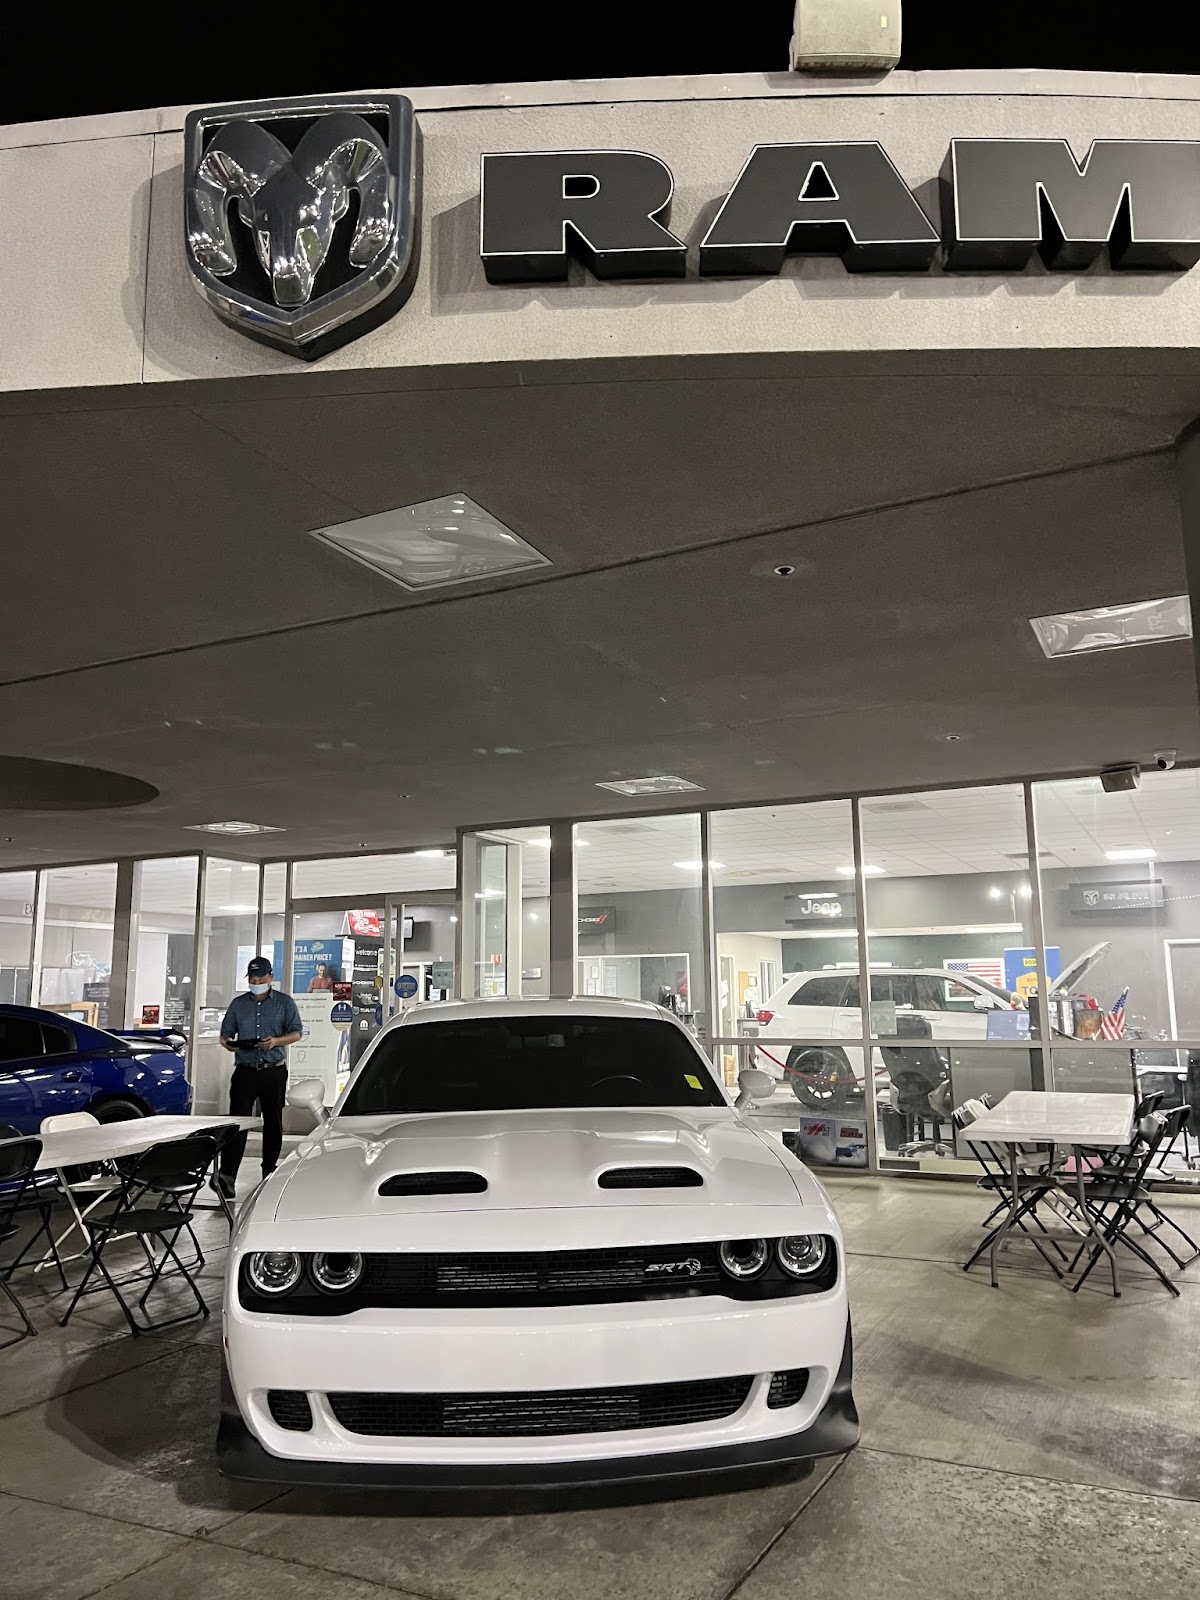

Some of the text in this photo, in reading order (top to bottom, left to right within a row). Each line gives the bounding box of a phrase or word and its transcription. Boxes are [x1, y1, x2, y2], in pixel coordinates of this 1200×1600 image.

[479, 137, 1200, 270] RAM
[801, 899, 842, 917] Jeep
[644, 1262, 690, 1273] SRT
